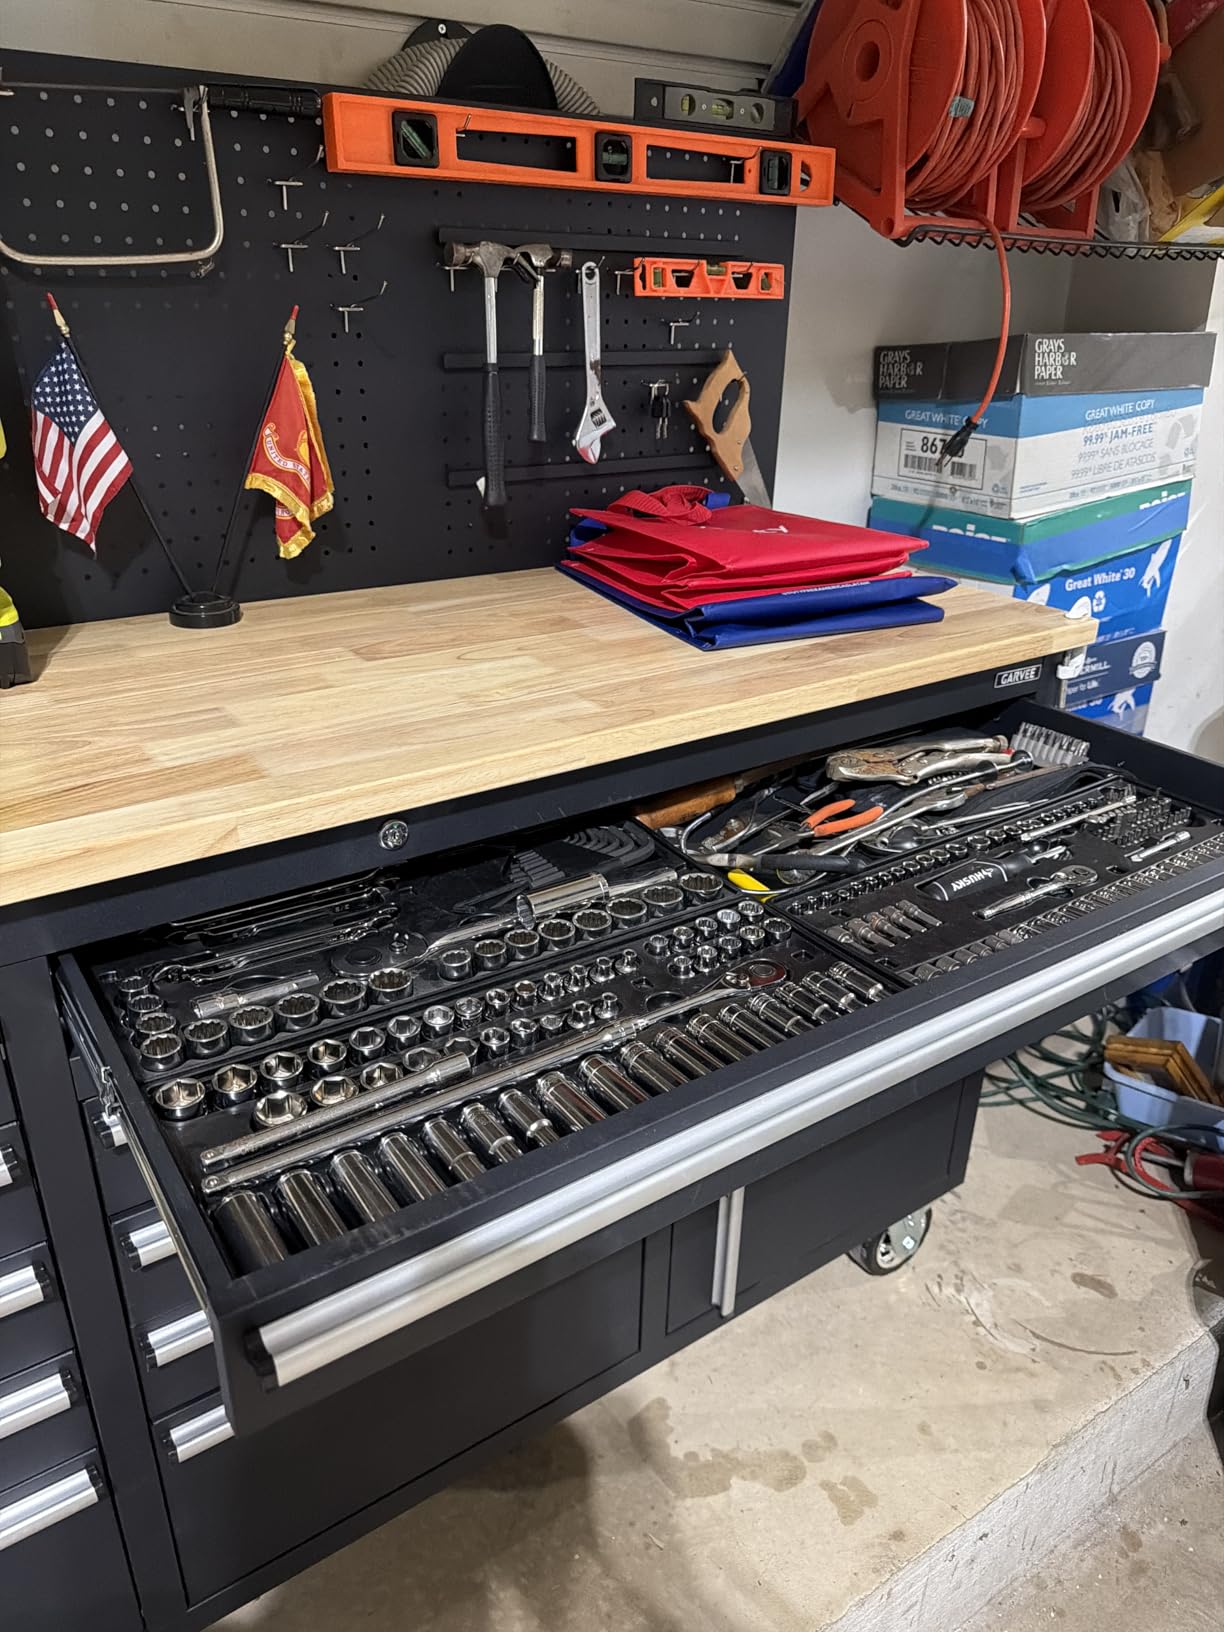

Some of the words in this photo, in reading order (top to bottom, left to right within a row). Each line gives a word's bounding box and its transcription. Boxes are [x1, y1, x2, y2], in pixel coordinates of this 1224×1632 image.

[1035, 338, 1065, 353] GRAYS
[880, 350, 910, 364] GRAYS
[879, 375, 908, 388] PAPER
[1034, 365, 1063, 380] PAPER
[1085, 406, 1108, 421] GREAT
[1135, 399, 1155, 412] COPY
[1109, 422, 1153, 444] JAM-FREE
[266, 440, 288, 466] UNITED
[1065, 577, 1092, 592] Great
[1123, 567, 1136, 580] 30
[1001, 667, 1037, 685] GARVEE
[951, 868, 985, 892] HUSKY
